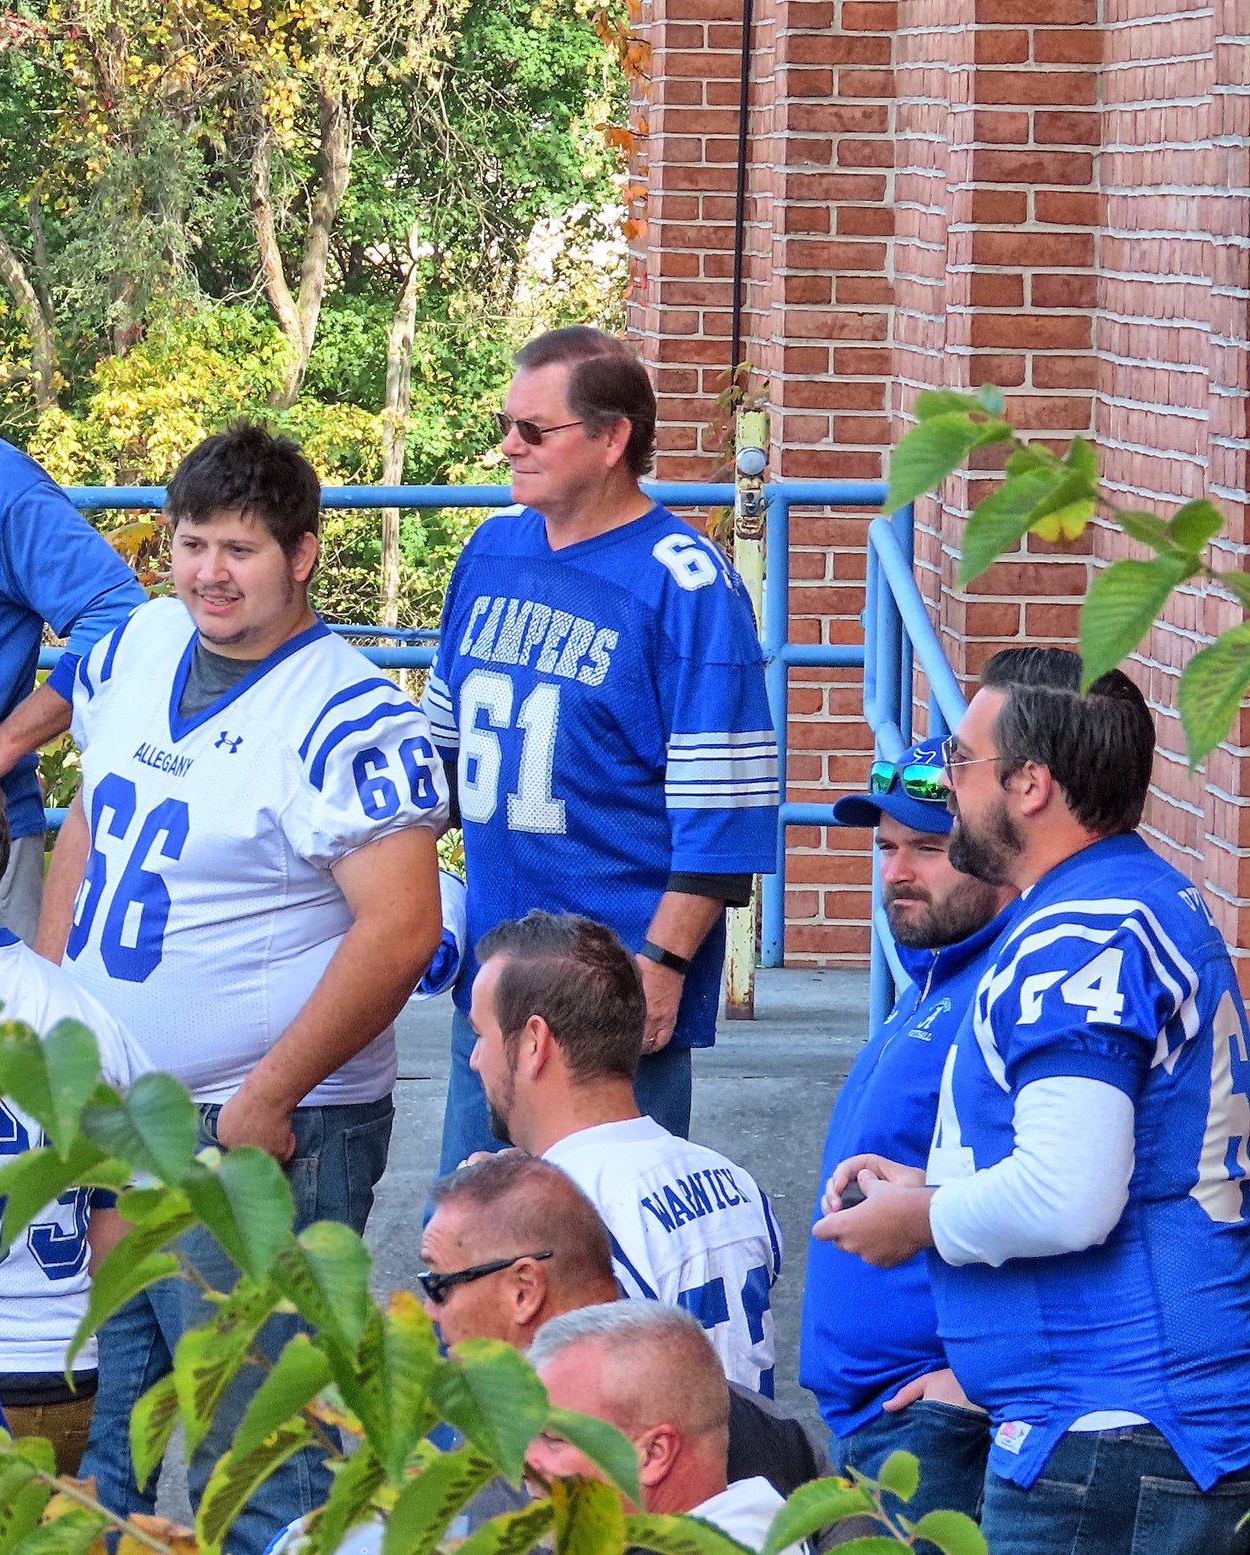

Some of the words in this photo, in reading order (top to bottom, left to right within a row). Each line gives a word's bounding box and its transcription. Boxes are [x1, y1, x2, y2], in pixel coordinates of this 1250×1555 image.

[459, 596, 619, 687] CAMPERS
[132, 742, 194, 778] ALLEGANY
[351, 735, 440, 821] 66
[457, 668, 567, 835] 61
[65, 771, 190, 984] 66
[640, 1167, 752, 1235] WARNICK
